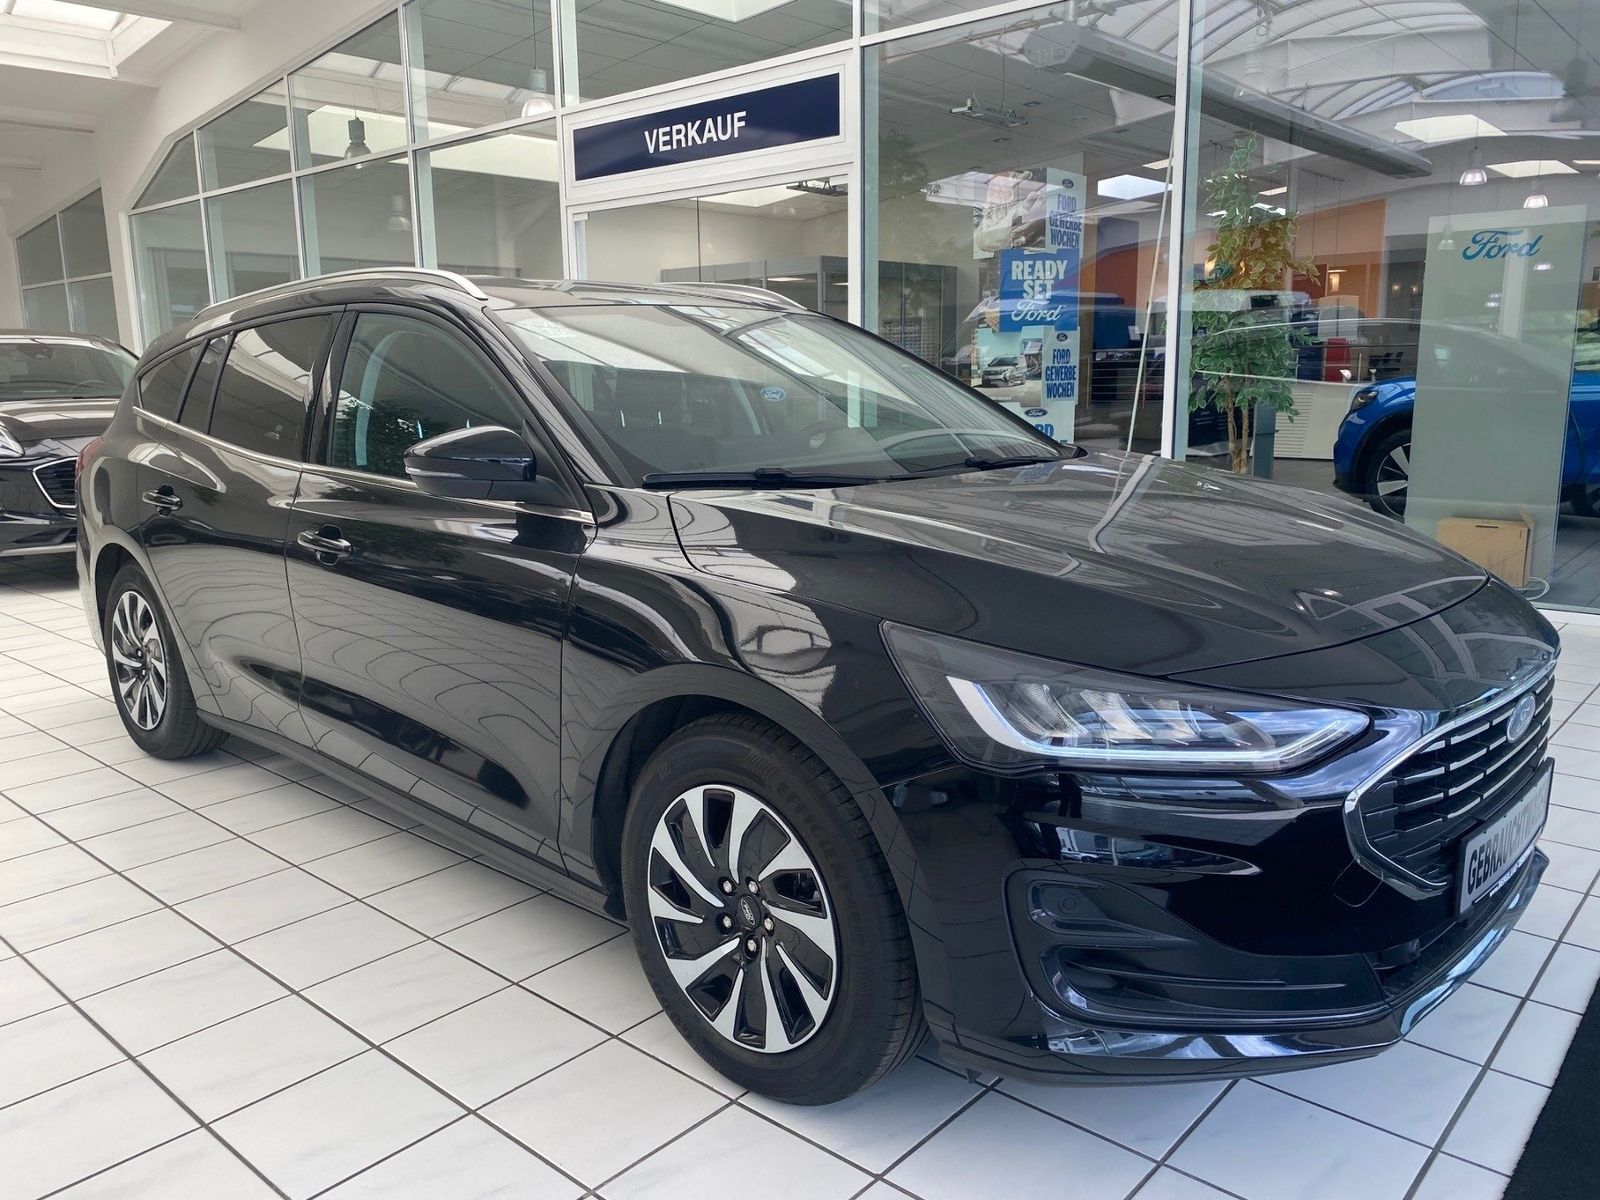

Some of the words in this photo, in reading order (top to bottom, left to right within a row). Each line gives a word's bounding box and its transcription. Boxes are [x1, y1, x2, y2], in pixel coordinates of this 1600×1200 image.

[644, 110, 747, 154] VERKAUF
[1057, 193, 1077, 213] FORD
[1050, 228, 1080, 249] WOCHEN
[1462, 229, 1544, 260] Ford
[1011, 260, 1068, 280] READY
[1023, 279, 1054, 300] SET
[1011, 299, 1066, 321] Ford
[1052, 348, 1071, 365] FORD
[1045, 365, 1077, 382] GEWERBE
[1046, 381, 1075, 399] WOCHEN
